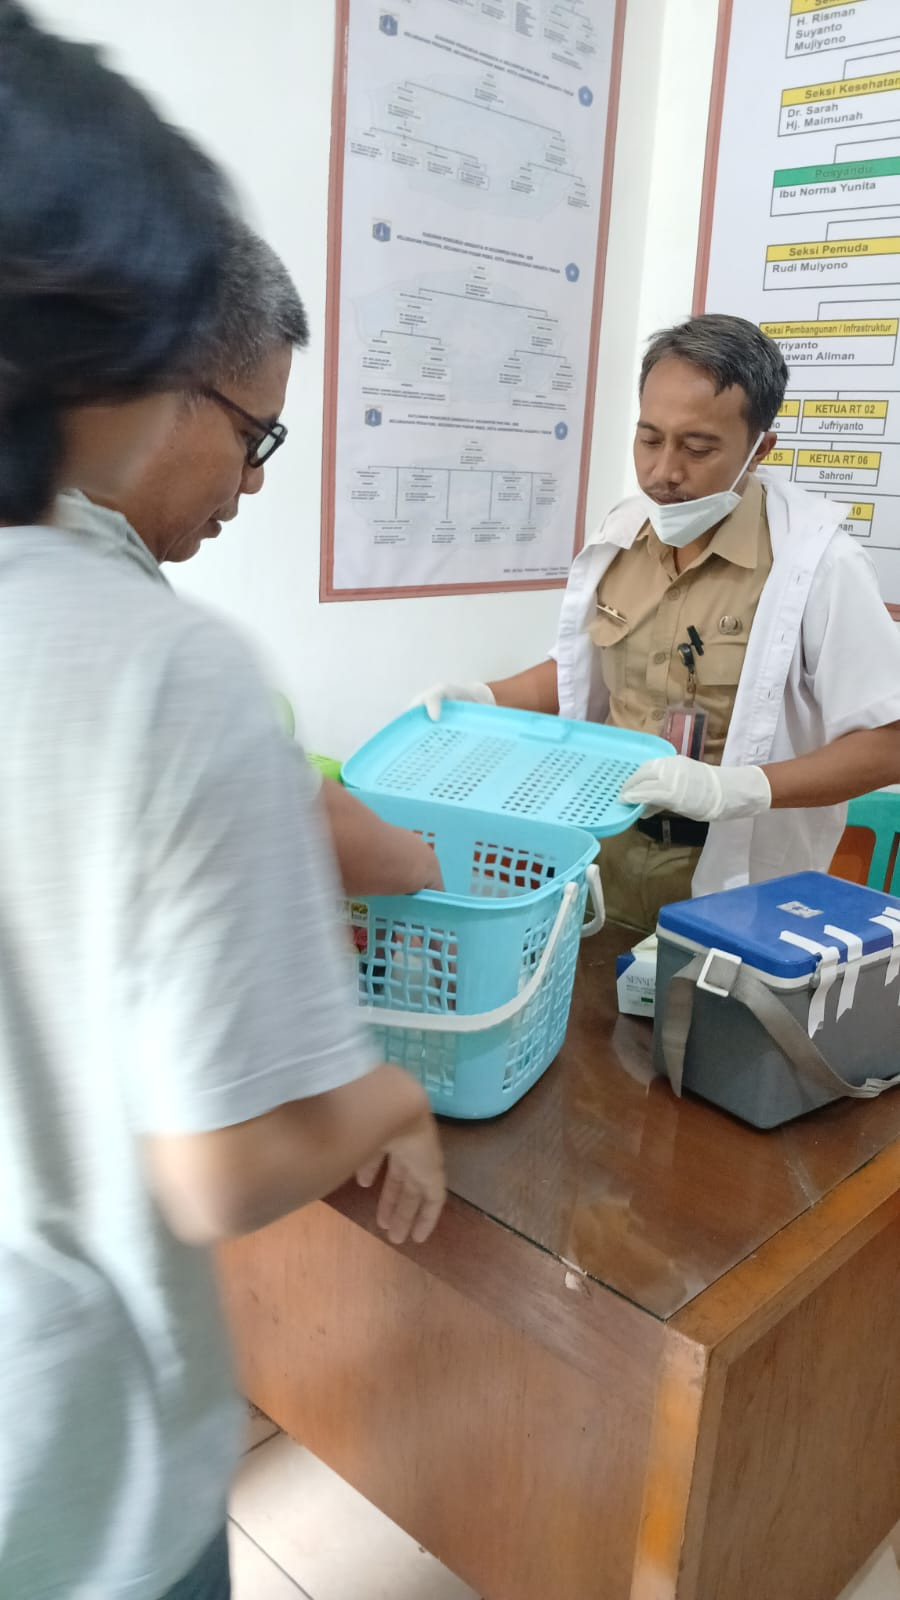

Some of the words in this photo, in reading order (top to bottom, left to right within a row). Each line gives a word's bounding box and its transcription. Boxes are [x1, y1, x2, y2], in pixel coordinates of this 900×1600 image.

[797, 18, 807, 26] H.
[812, 8, 856, 24] Risman
[796, 24, 842, 39] Suyanto
[794, 35, 846, 51] Mujiyono
[805, 88, 836, 99] Seksi
[840, 77, 900, 94] Kesehatan
[787, 109, 802, 118] Dr.
[806, 103, 838, 115] Sarah
[786, 121, 799, 131] Hj.
[804, 112, 863, 126] Maimunah
[816, 166, 873, 178] Posyandu
[780, 190, 796, 198] Ibu
[800, 186, 836, 196] Norma
[840, 182, 876, 192] Yunita
[789, 247, 818, 256] Seksi
[822, 243, 868, 254] Pemuda
[772, 264, 796, 273] Rudi
[765, 326, 783, 334] Seksi
[786, 325, 837, 336] Pembangunan
[843, 324, 891, 333] Infrastruktur
[778, 341, 818, 351] friyanto
[784, 353, 813, 361] awan
[816, 352, 854, 360] Aliman
[816, 404, 846, 414] KETUA
[849, 405, 860, 414] RT
[865, 405, 875, 414] 02
[819, 421, 863, 432] Jufriyanto
[773, 453, 783, 461] 05
[809, 454, 840, 464] KETUA
[843, 455, 855, 464] RT
[858, 456, 868, 464] 06
[819, 471, 853, 480] Sahroni
